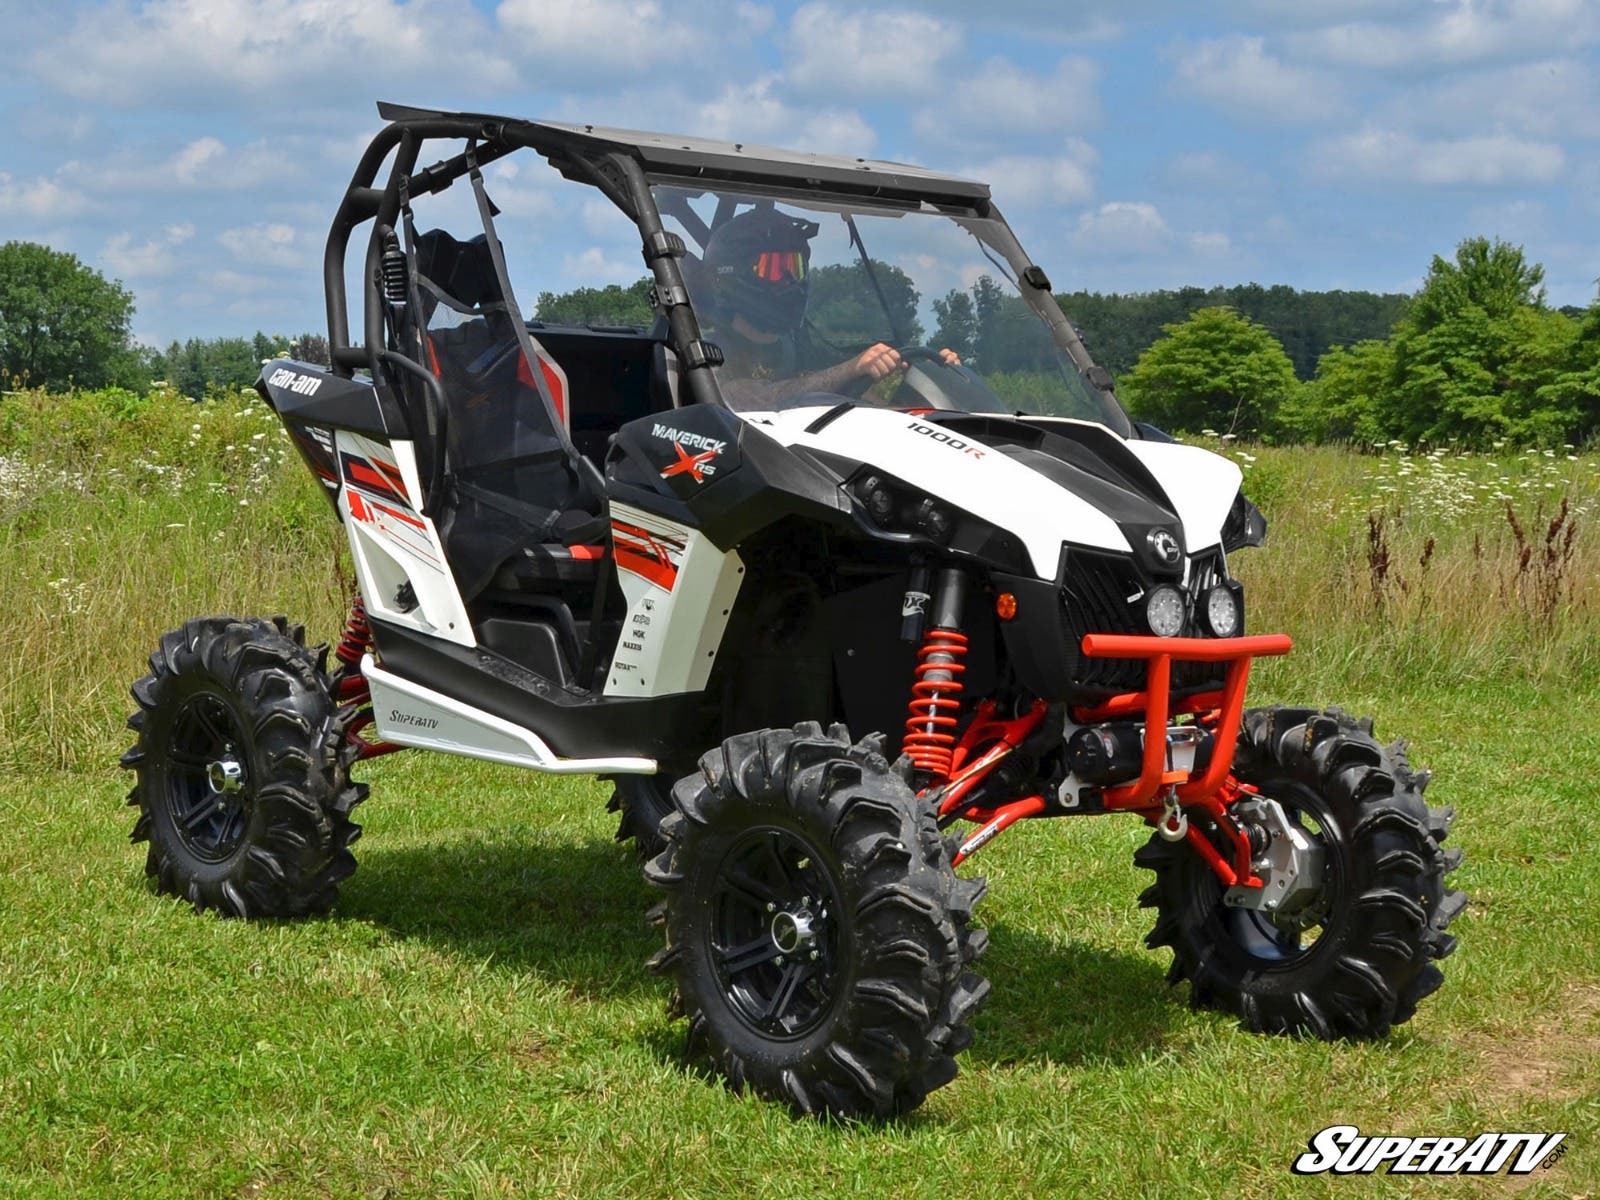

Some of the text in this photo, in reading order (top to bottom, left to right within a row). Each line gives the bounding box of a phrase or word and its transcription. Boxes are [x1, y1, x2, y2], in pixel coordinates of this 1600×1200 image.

[268, 367, 323, 397] can-am
[651, 423, 728, 455] MAVERICK
[907, 422, 986, 460] 1000R
